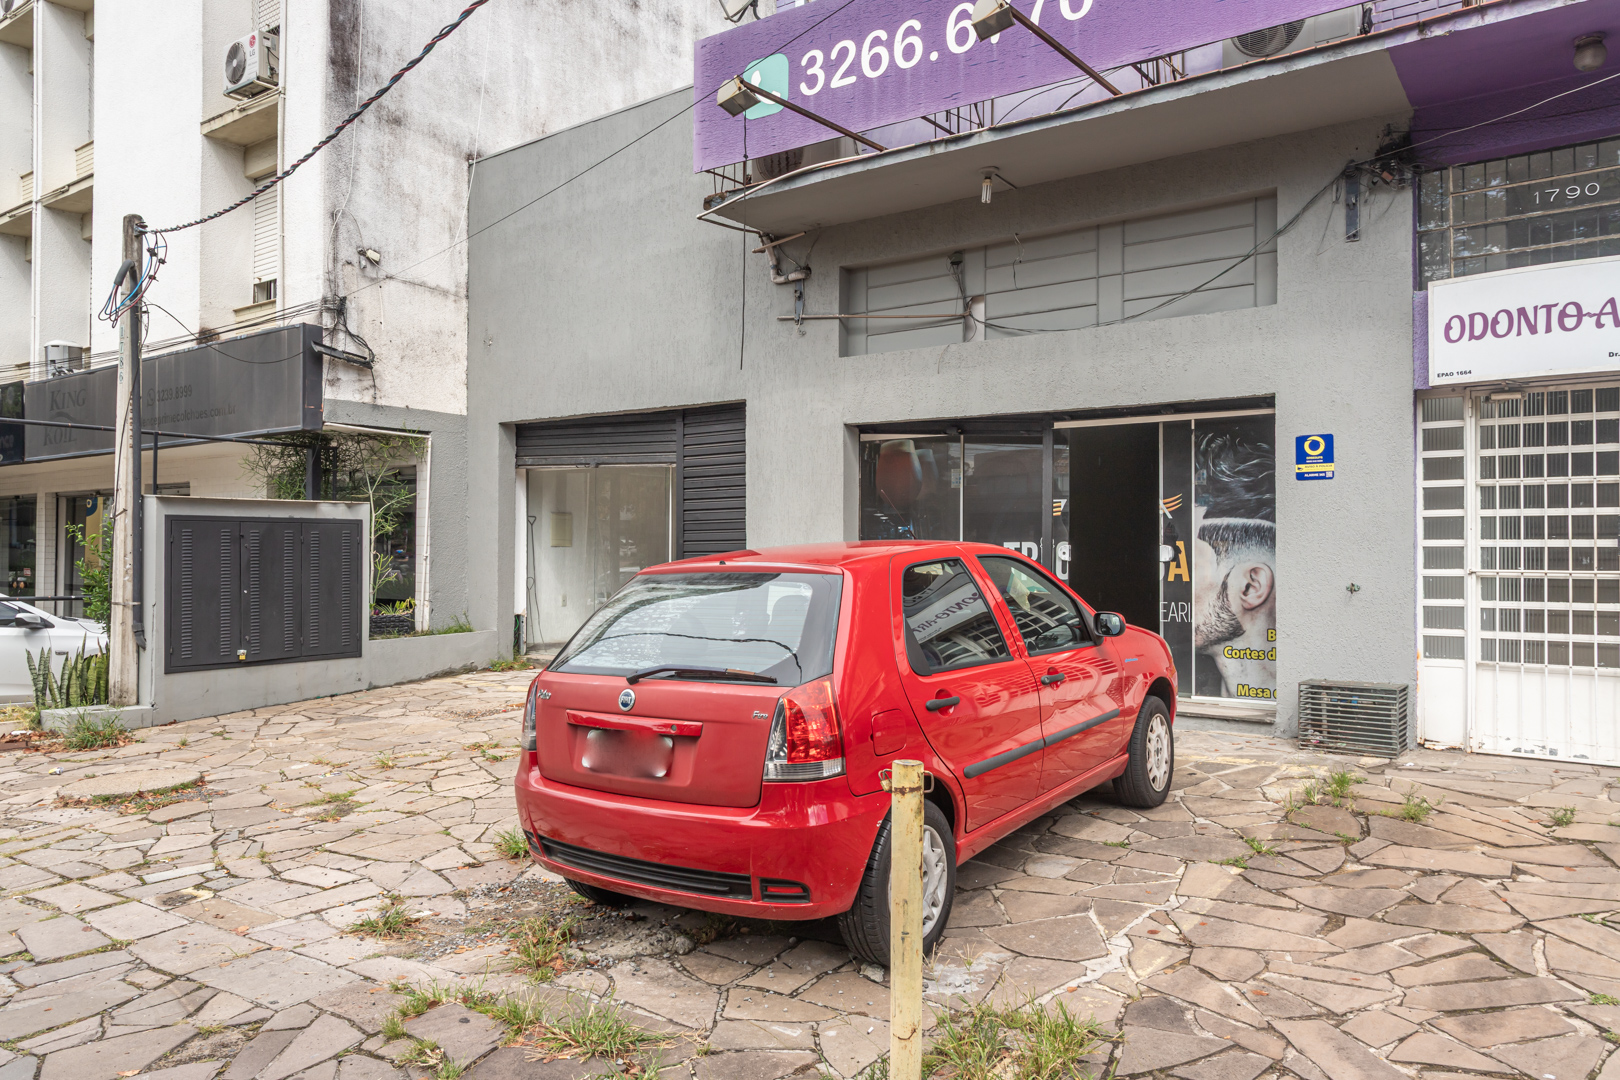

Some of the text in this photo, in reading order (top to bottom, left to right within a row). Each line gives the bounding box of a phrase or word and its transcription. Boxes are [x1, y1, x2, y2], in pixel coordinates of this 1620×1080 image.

[249, 49, 256, 57] LG
[1534, 182, 1600, 204] 1790
[48, 388, 87, 411] KING
[1223, 646, 1265, 660] Cortes
[1237, 683, 1271, 699] Mesa
[620, 695, 632, 704] FIAT
